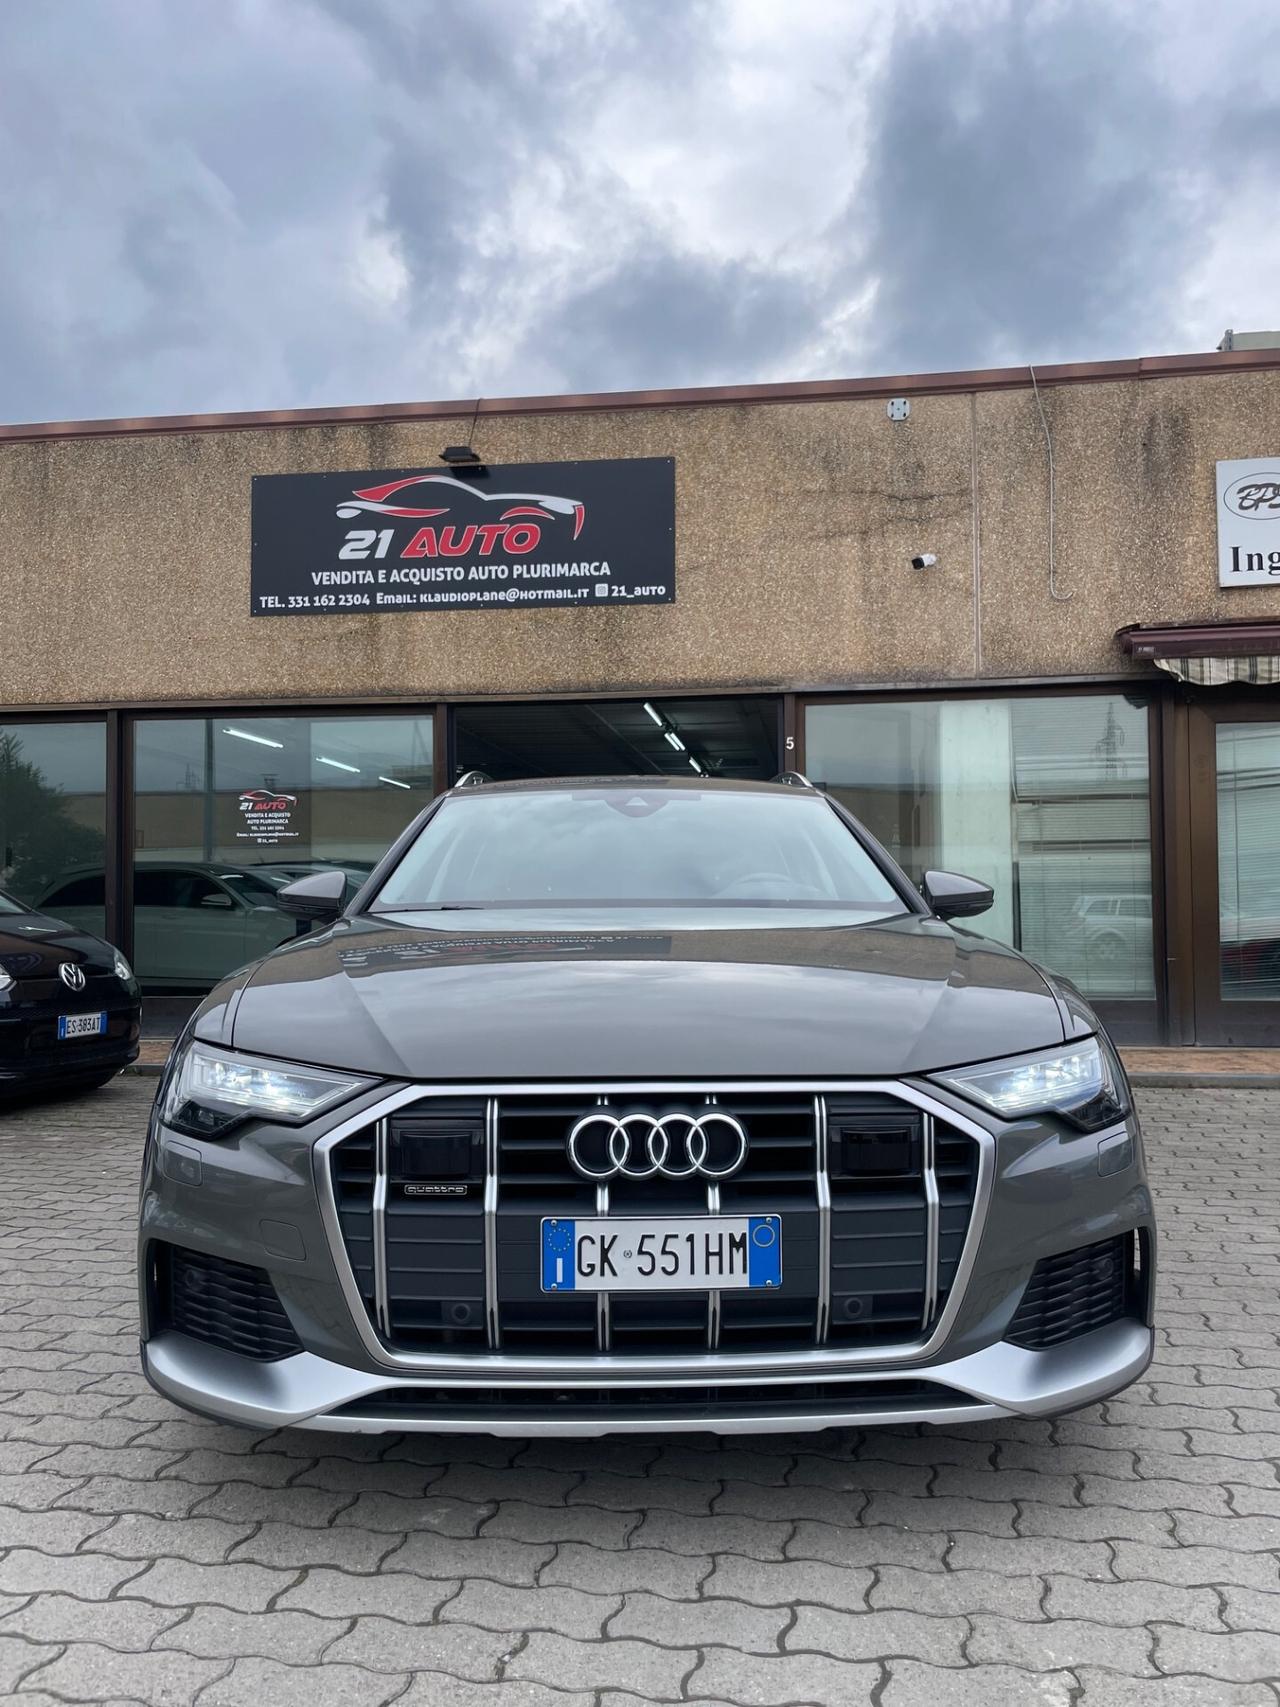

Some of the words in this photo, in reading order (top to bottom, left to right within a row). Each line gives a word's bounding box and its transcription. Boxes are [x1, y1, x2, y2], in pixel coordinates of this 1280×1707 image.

[338, 529, 395, 560] 21
[400, 523, 541, 558] AUTO
[312, 570, 375, 585] VENDITA
[378, 570, 387, 583] E
[390, 567, 464, 585] ACQUISTO
[468, 565, 509, 580] AUTO
[513, 562, 611, 579] PLURIMARCA
[260, 596, 285, 608] TEL.
[288, 596, 310, 608] 331
[313, 594, 336, 607] 162
[339, 593, 370, 606] 2304
[786, 736, 794, 750] 5
[239, 802, 253, 811] 21
[254, 801, 286, 811] AUTO
[407, 1185, 464, 1193] quattro
[577, 1234, 618, 1277] GK
[637, 1232, 748, 1276] 551HM
